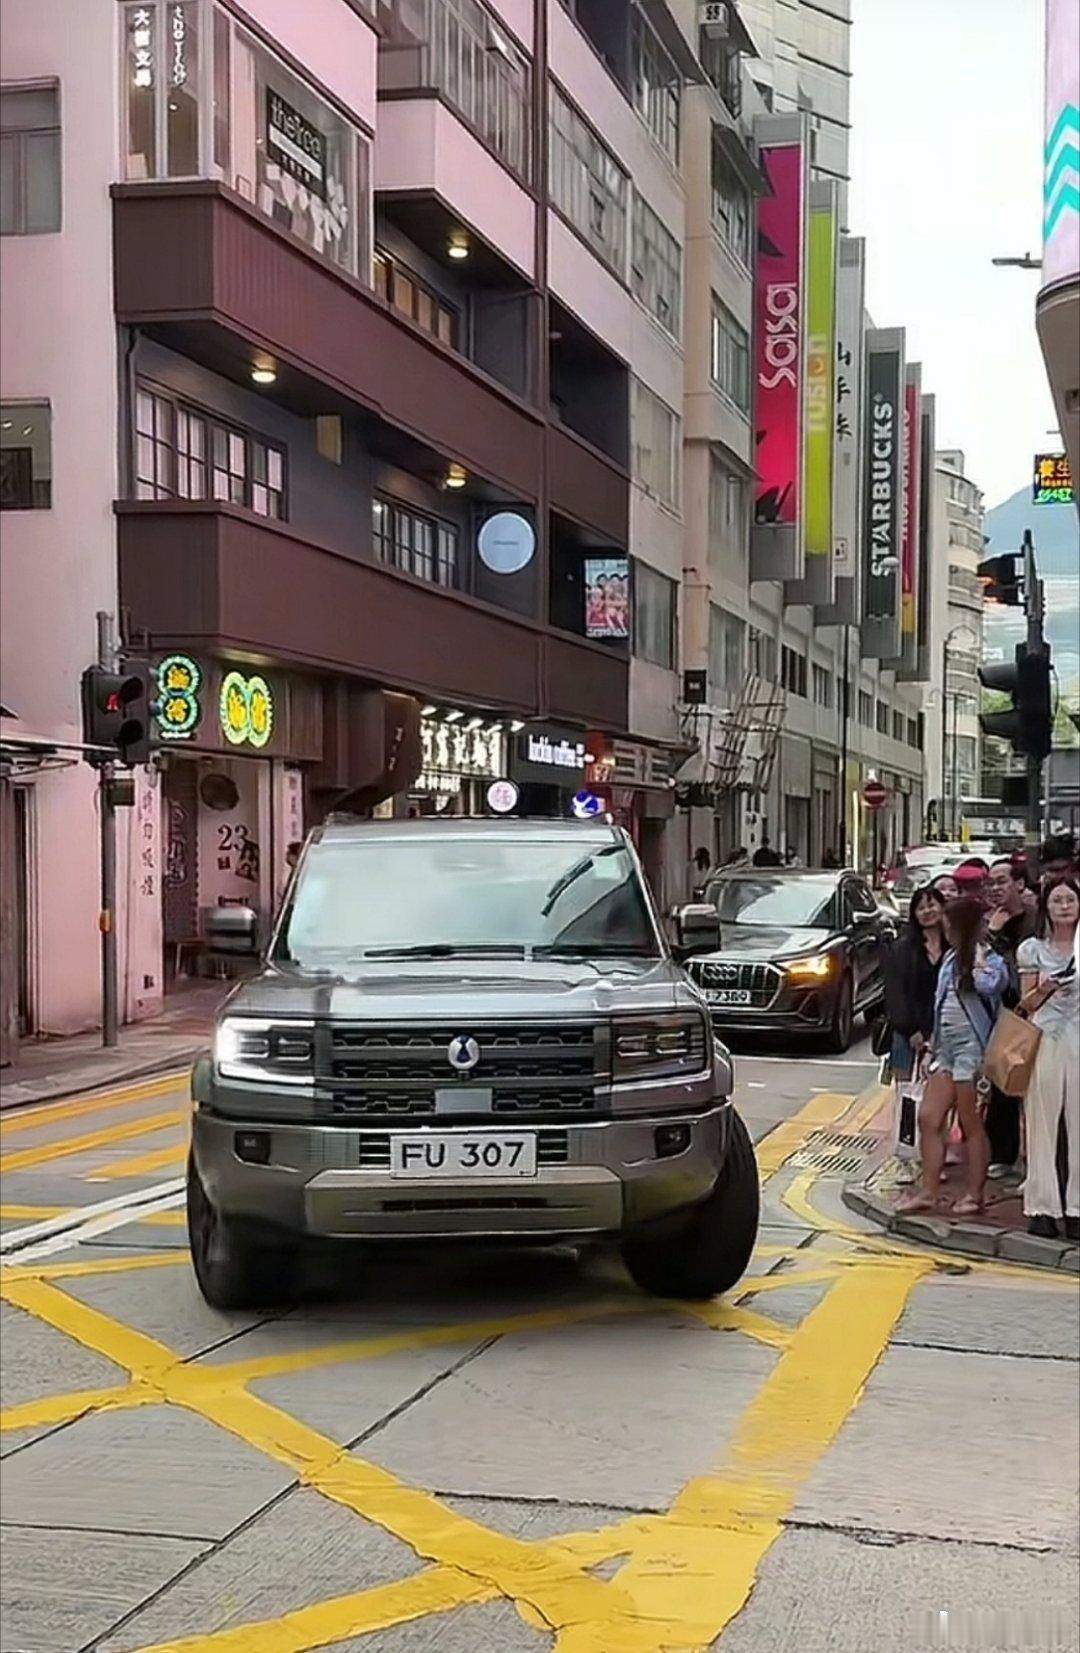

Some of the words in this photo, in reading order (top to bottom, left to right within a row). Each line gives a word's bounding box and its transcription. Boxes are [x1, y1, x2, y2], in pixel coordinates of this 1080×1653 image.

[871, 402, 893, 577] STARBUCKS
[401, 1142, 446, 1169] FU
[459, 1141, 525, 1168] 307
